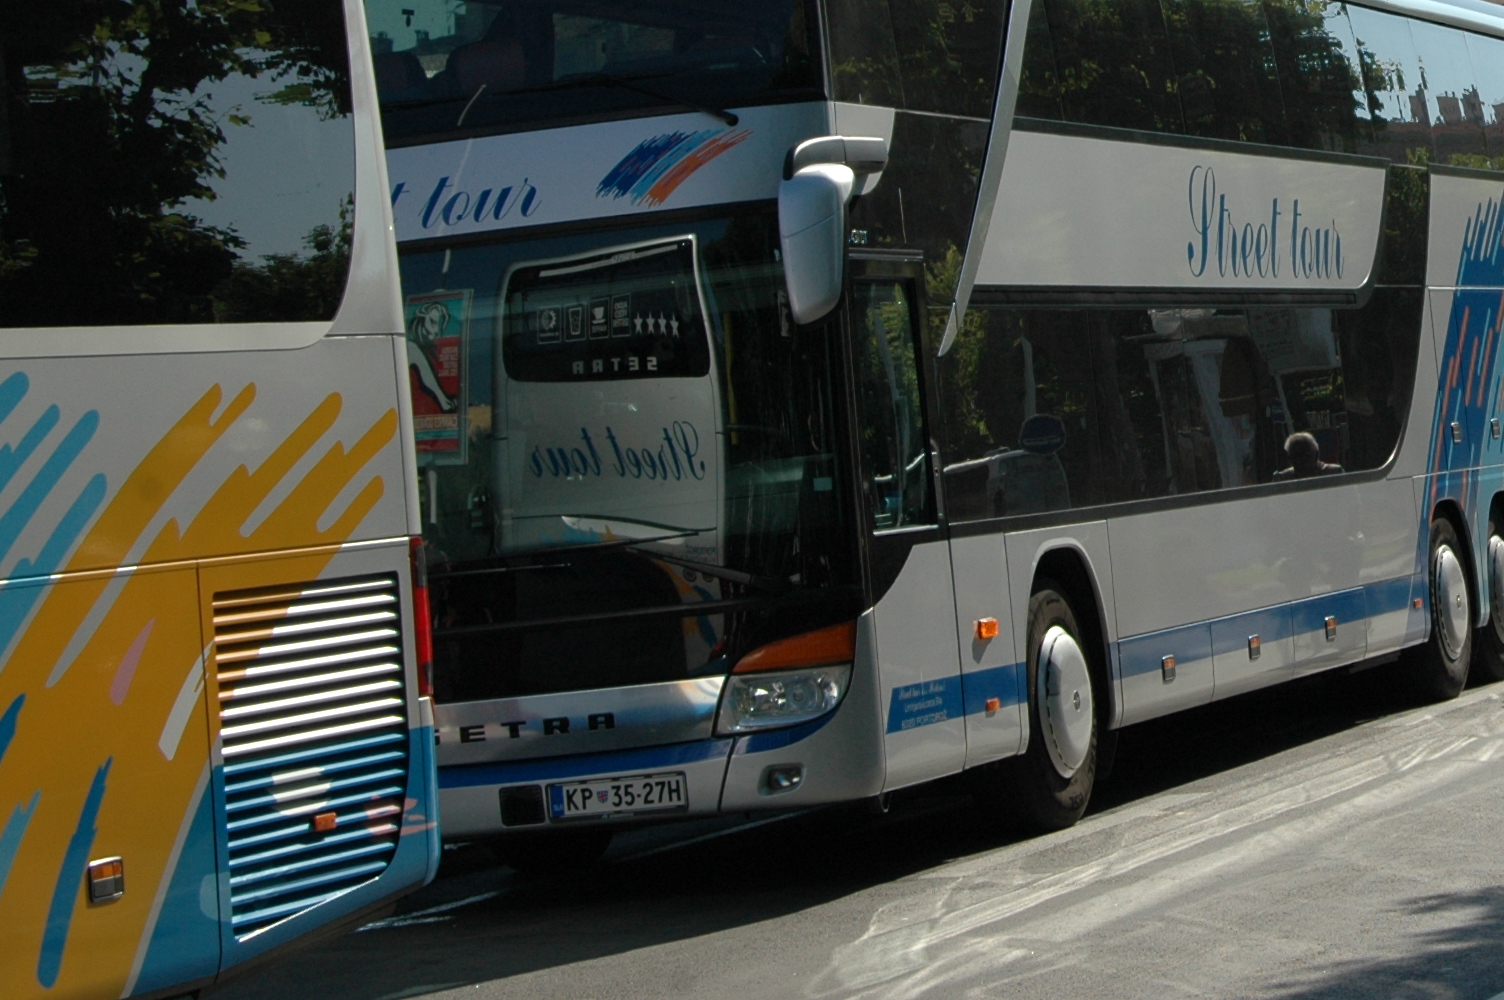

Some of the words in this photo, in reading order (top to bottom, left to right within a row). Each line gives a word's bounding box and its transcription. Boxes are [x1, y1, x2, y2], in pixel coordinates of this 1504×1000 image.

[419, 176, 542, 229] tour
[1187, 165, 1281, 278] Street
[1291, 198, 1344, 280] tour
[435, 713, 616, 744] ETRA
[566, 788, 593, 812] KP
